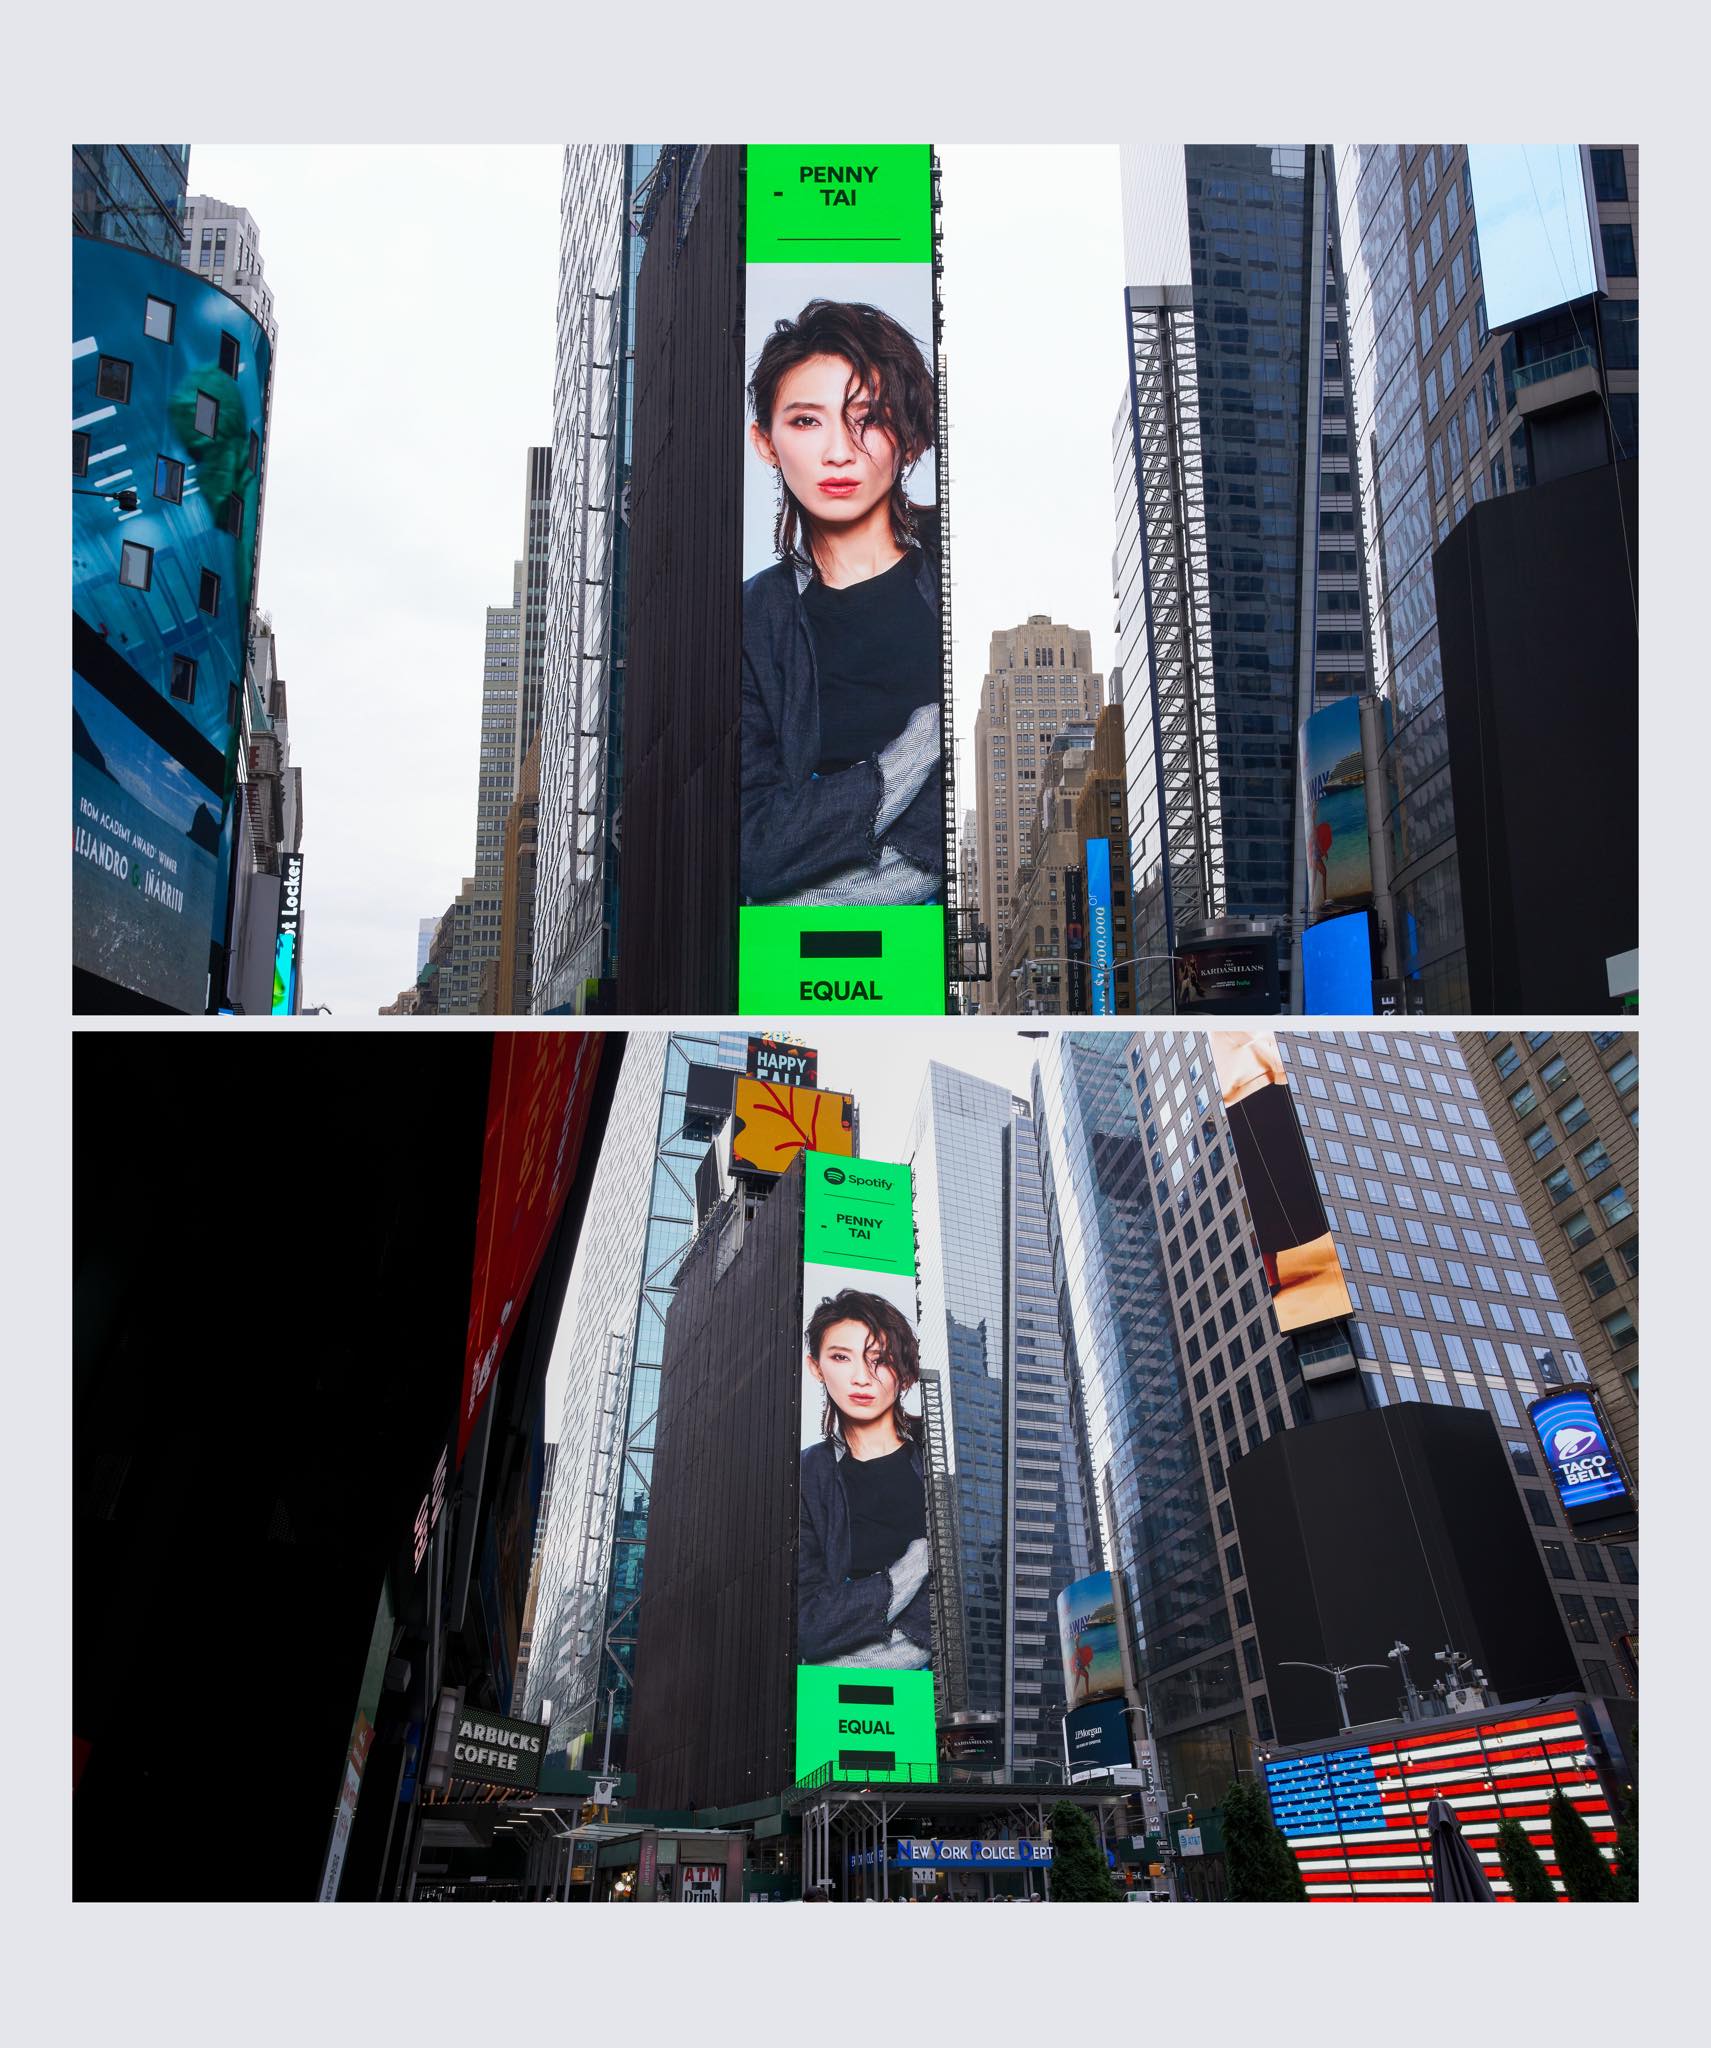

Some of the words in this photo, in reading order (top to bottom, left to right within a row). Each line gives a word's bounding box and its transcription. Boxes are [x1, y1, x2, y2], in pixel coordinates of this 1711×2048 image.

[799, 166, 879, 183] PENNY
[819, 189, 857, 206] TAI
[80, 797, 99, 821] FROM
[100, 813, 131, 843] ACADEMY
[159, 850, 177, 874] WINNER
[73, 826, 129, 880] LEJANDRO
[281, 858, 301, 916] Locker
[1201, 965, 1264, 976] KARDASHIANS
[800, 980, 883, 1002] EQUAL
[757, 1050, 807, 1073] HAPPY
[848, 1174, 893, 1191] Spotify
[836, 1213, 883, 1229] PENNY
[848, 1227, 871, 1240] TAI
[1558, 1455, 1606, 1475] TACO
[1566, 1467, 1612, 1486] BELL
[459, 1720, 541, 1753] ARBUCKS
[838, 1719, 895, 1735] EQUAL
[454, 1743, 518, 1771] COFFEE
[898, 1840, 930, 1860] NEW
[931, 1840, 968, 1860] YORK
[970, 1840, 1015, 1860] POLICE
[1018, 1840, 1053, 1860] DEPT
[684, 1867, 720, 1882] ATM
[684, 1889, 719, 1902] Drink
